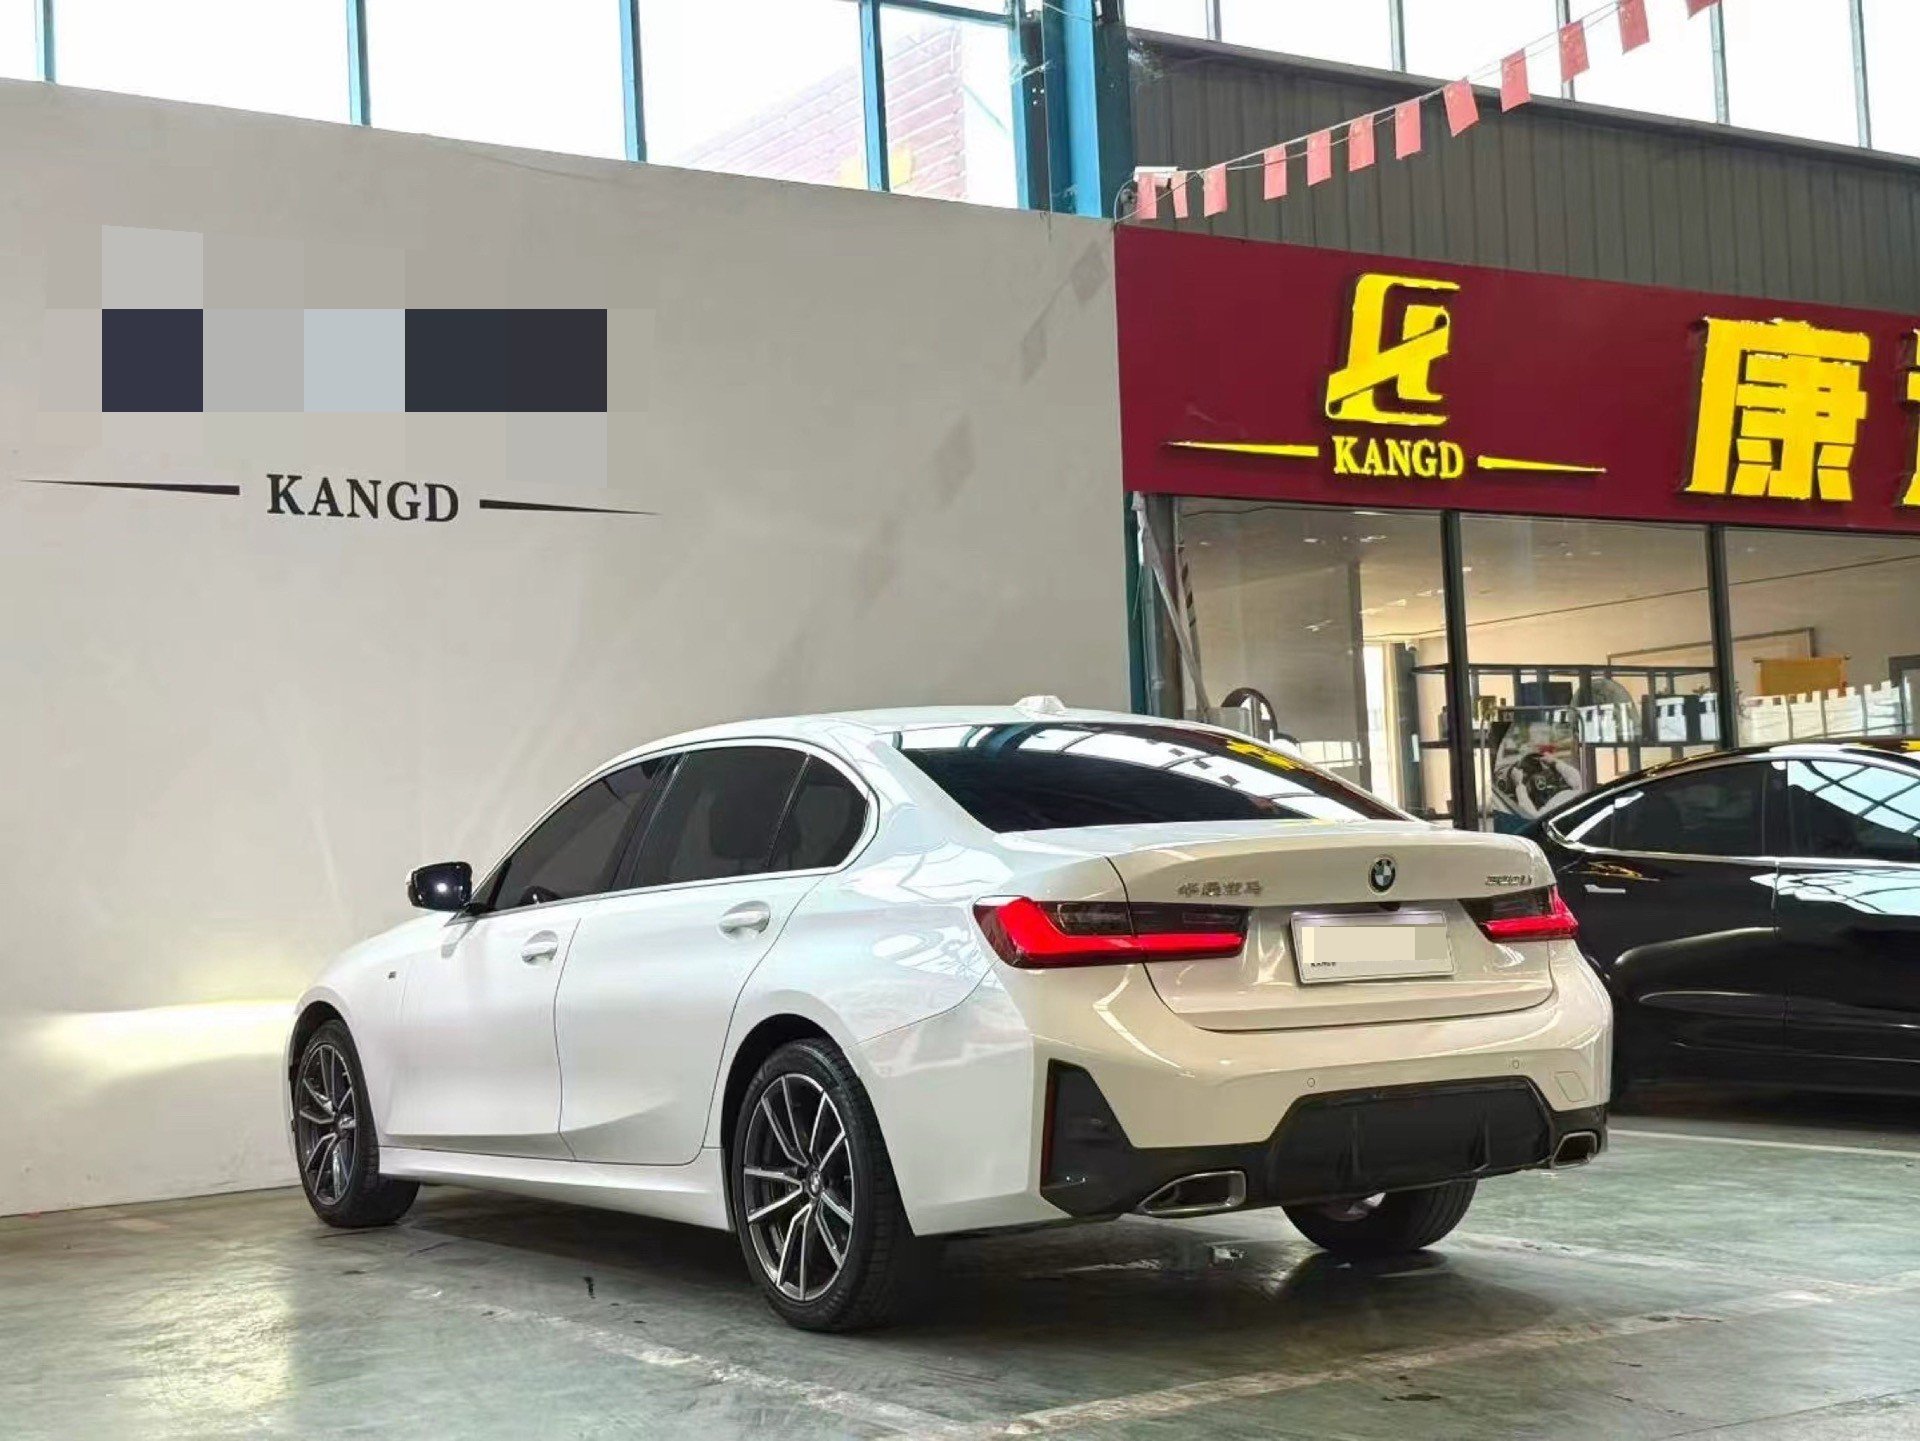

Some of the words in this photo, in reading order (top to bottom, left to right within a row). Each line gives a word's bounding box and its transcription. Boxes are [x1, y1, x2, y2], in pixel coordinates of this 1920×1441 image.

[1684, 317, 1920, 507] 康
[1331, 435, 1465, 480] KANGD
[266, 473, 459, 523] KANGD
